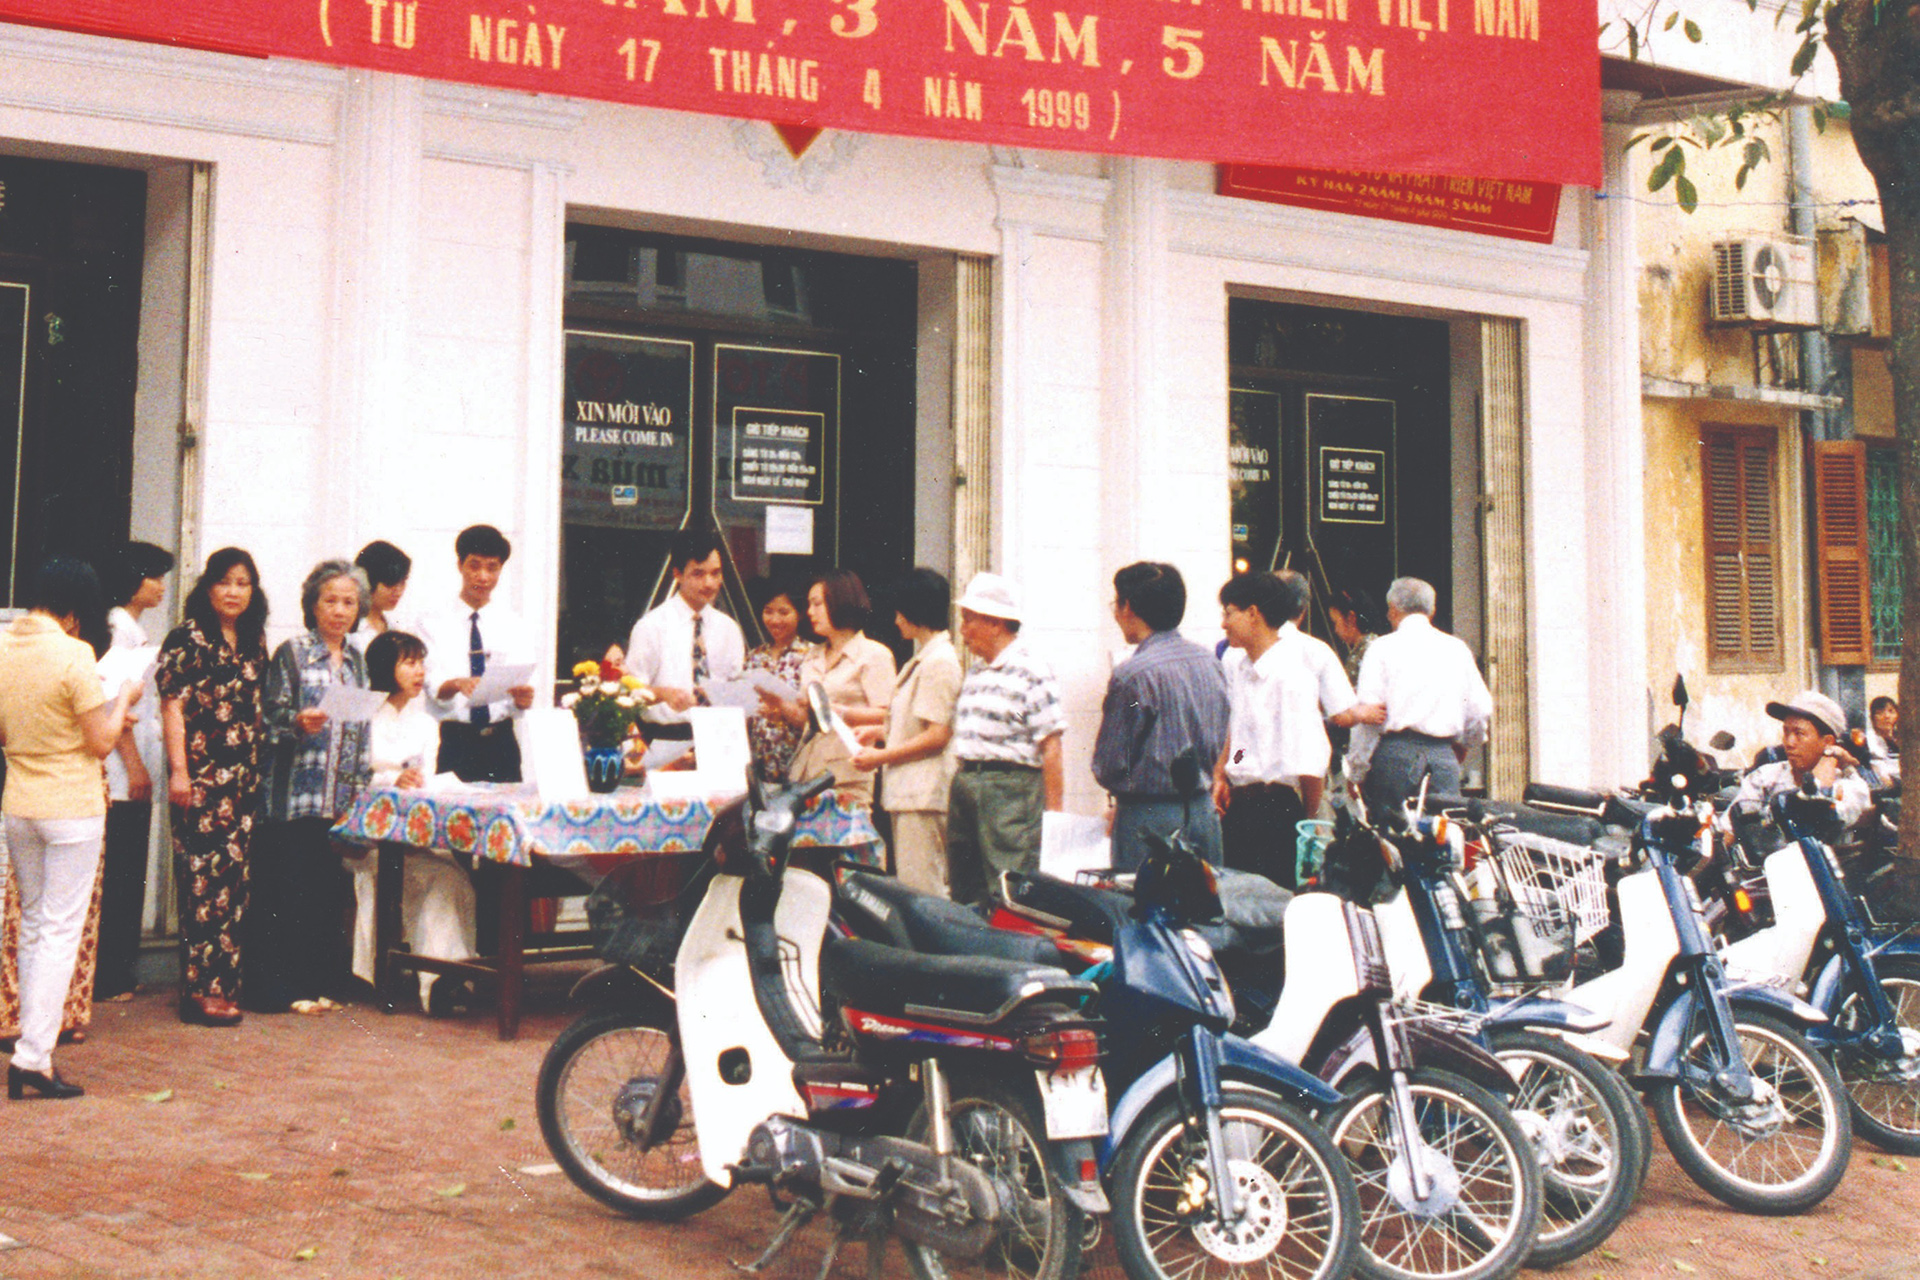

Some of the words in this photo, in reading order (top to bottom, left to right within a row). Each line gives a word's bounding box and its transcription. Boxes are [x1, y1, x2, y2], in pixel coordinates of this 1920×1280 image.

[469, 5, 567, 70] NGÀY
[617, 38, 662, 82] 17
[708, 40, 819, 102] THÁNG
[863, 68, 882, 110] 4
[1161, 25, 1204, 79] 5
[1260, 30, 1386, 96] NĂM
[575, 425, 621, 445] PLEASE
[621, 428, 659, 447] COME
[660, 431, 675, 447] IN
[576, 400, 605, 422] XIN
[606, 399, 640, 426] MỜI
[641, 401, 672, 427] VÀO
